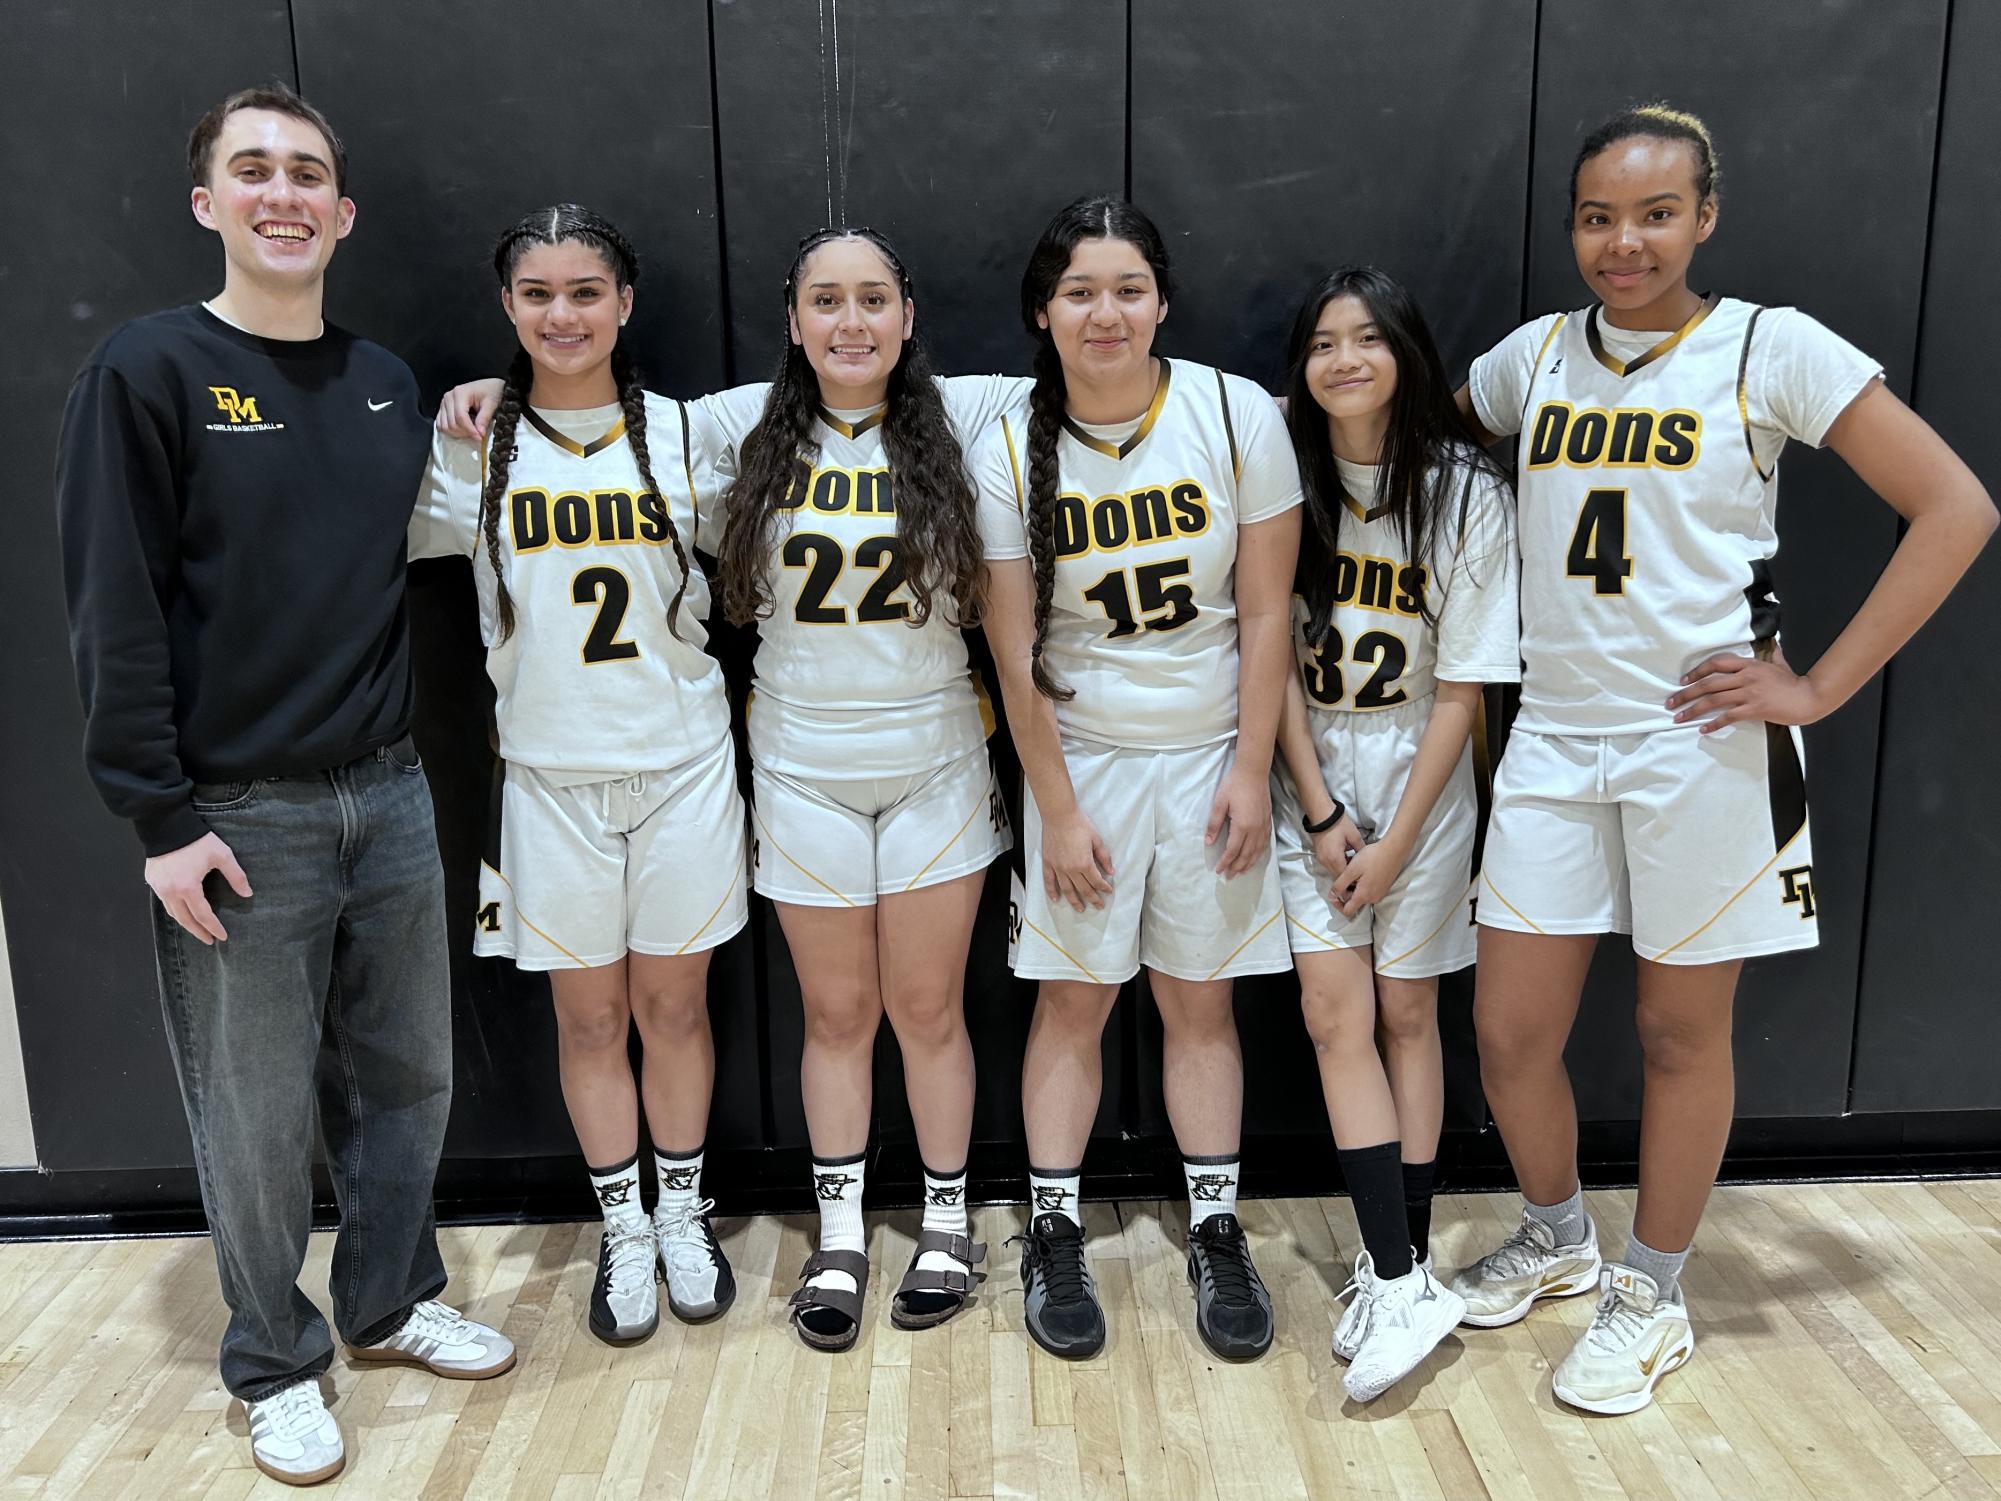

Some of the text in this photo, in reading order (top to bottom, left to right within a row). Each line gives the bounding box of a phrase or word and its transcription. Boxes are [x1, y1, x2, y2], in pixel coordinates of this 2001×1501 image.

[213, 422, 276, 432] GIRLS BASKETBALL
[1526, 399, 1703, 472] Dons
[508, 486, 672, 556] Dons
[772, 459, 897, 518] Don
[1055, 478, 1212, 561] Dons
[783, 531, 913, 625] 22
[1565, 487, 1635, 597] 4
[570, 564, 642, 666] 2
[1081, 556, 1199, 640] 15
[1333, 550, 1430, 619] ons
[1302, 620, 1409, 712] 32
